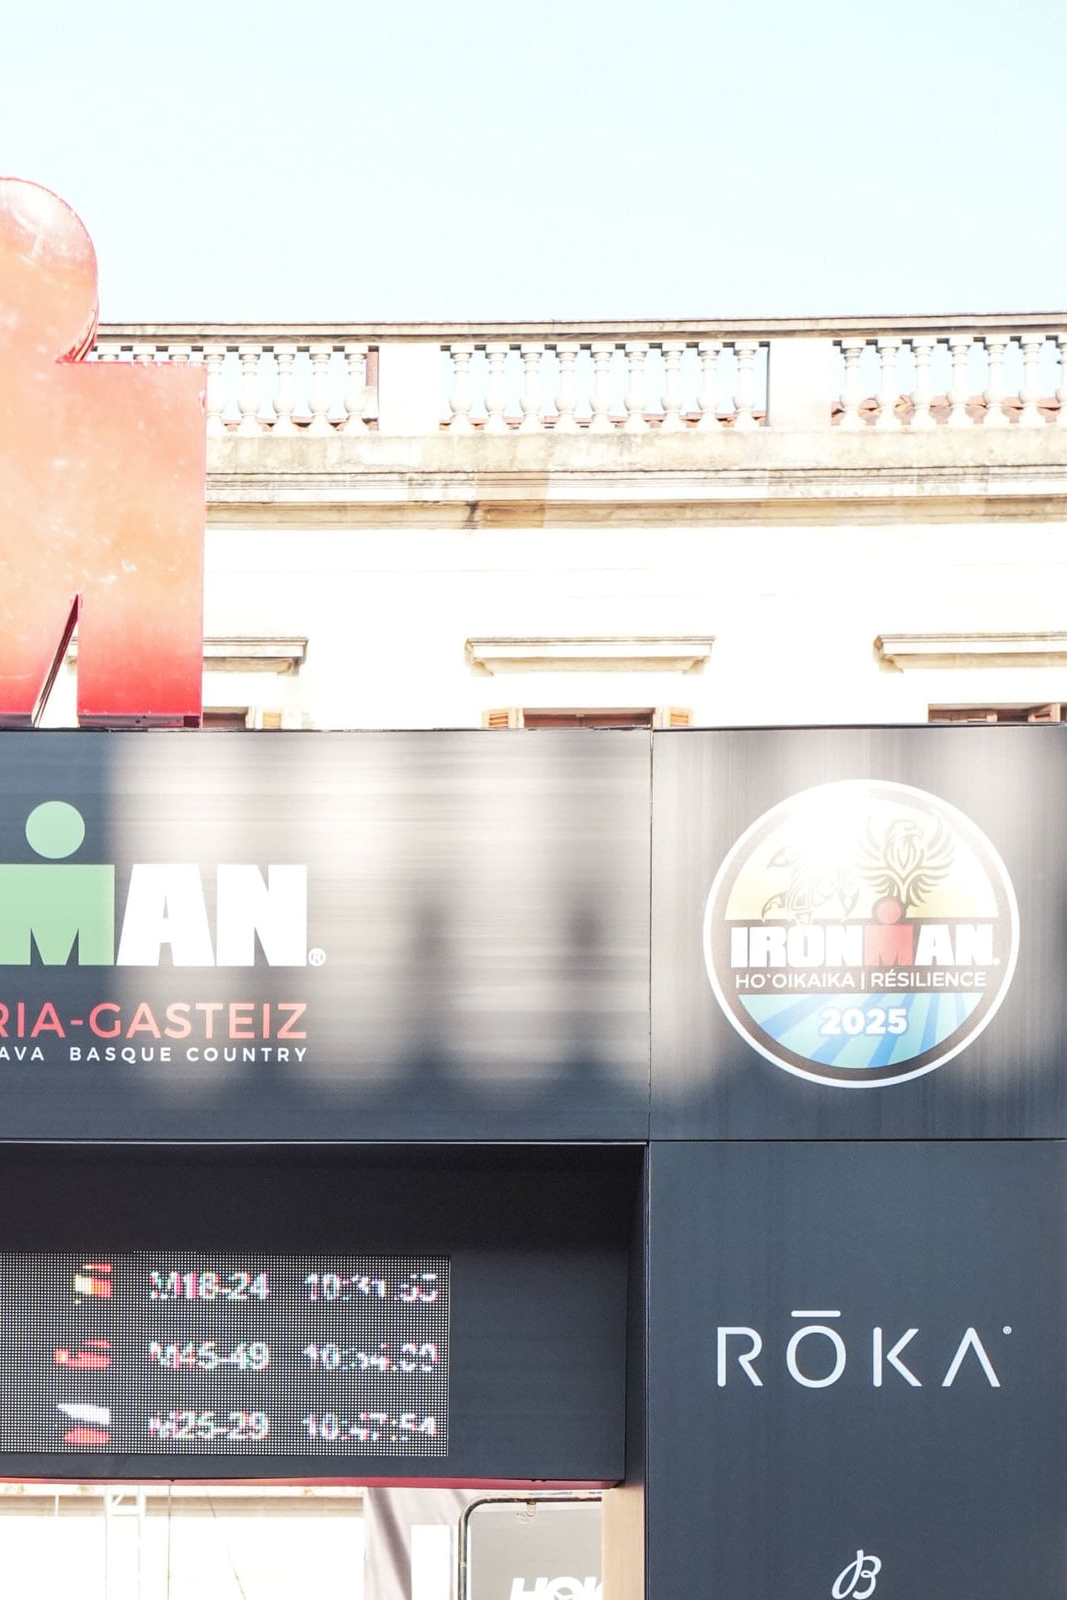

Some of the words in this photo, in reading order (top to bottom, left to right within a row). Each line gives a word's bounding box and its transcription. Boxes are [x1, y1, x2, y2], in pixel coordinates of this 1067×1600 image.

[731, 924, 994, 968] IRONMAN
[871, 969, 987, 988] RÉSILIENCE
[820, 1008, 908, 1036] 2025
[70, 1047, 173, 1064] BASQUE
[186, 1047, 307, 1063] COUNTRY
[149, 1341, 271, 1371] M45-49
[149, 1410, 271, 1441] M25-29
